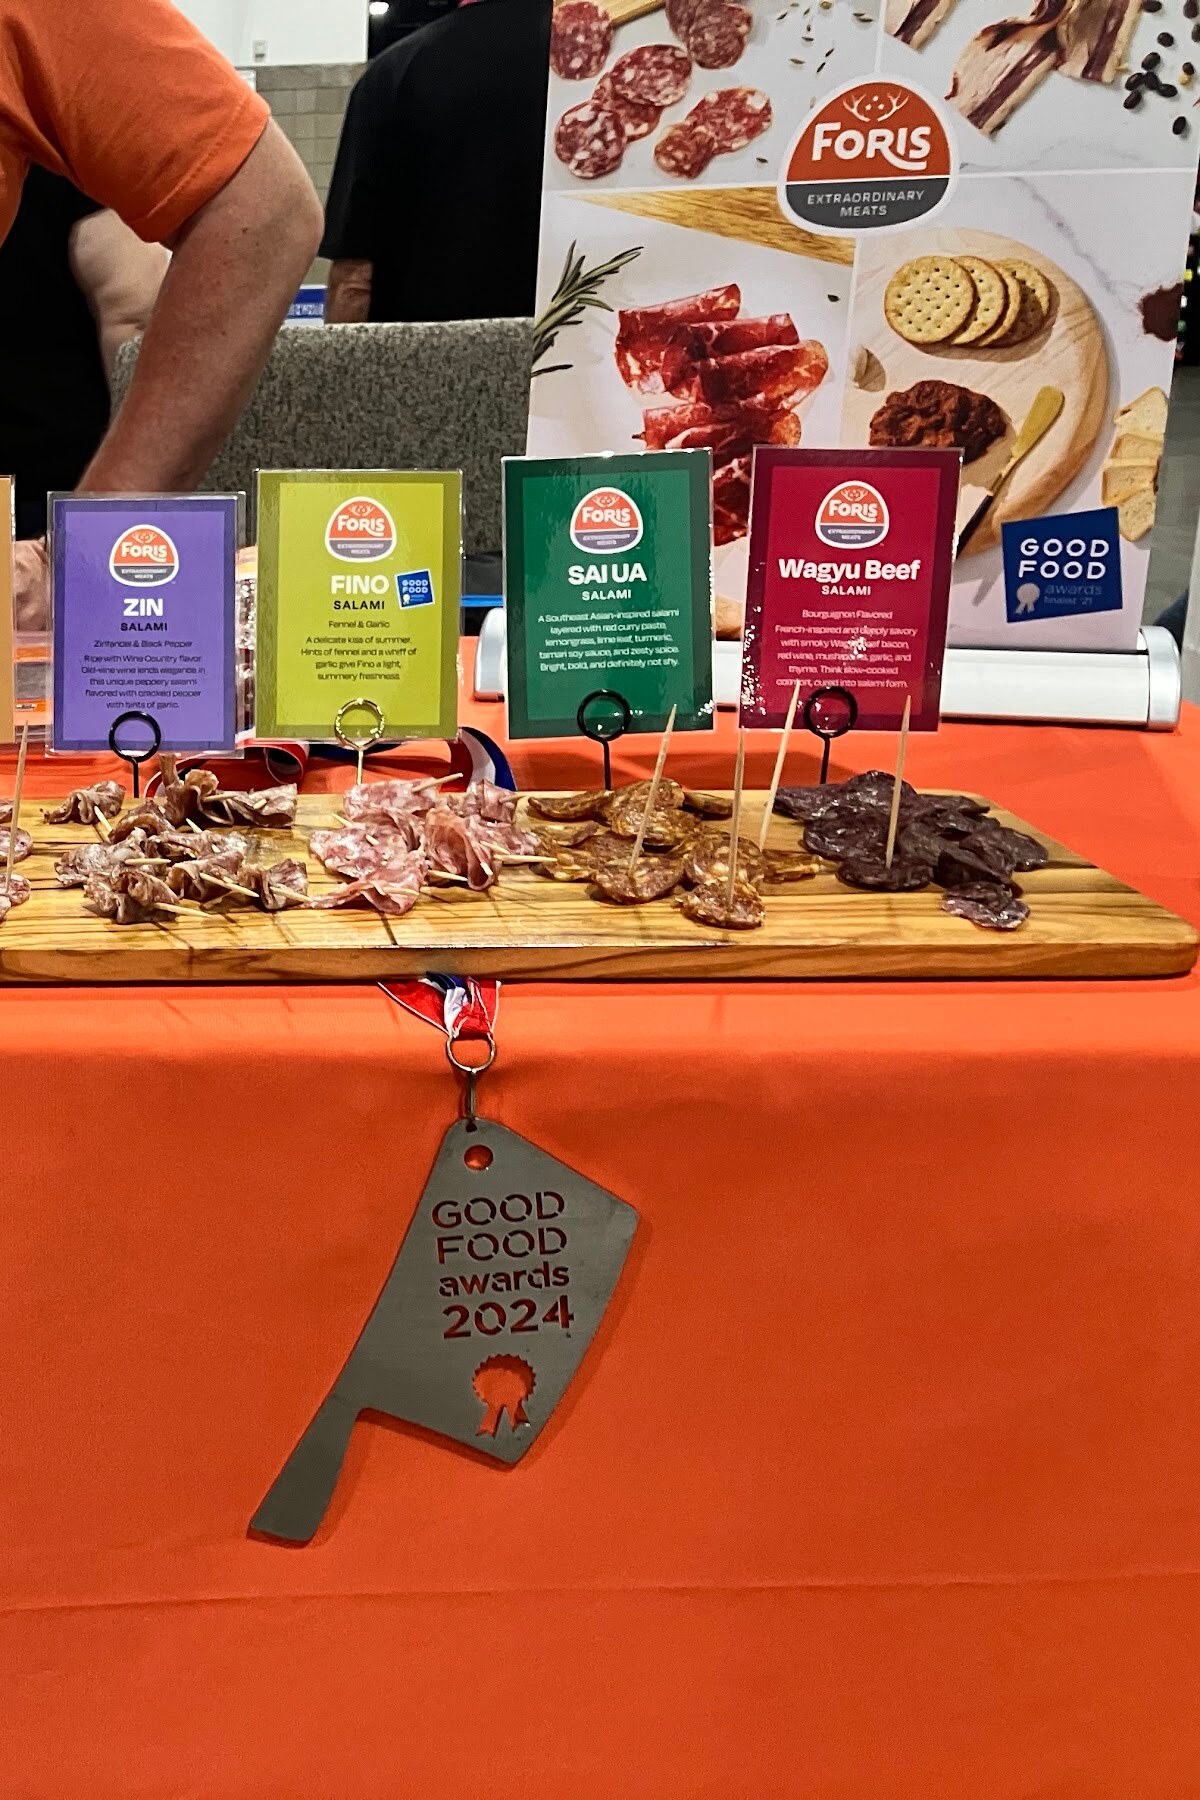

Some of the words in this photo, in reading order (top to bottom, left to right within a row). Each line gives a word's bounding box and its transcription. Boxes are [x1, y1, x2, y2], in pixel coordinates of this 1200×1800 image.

[812, 122, 931, 170] FORIS
[808, 190, 924, 204] EXTRAORDINARY
[840, 205, 887, 217] MEATS
[582, 507, 630, 527] FORIS
[829, 499, 878, 522] FORIS
[338, 515, 385, 537] FORIS
[121, 542, 167, 562] FORIS
[1021, 538, 1109, 557] GOOD
[568, 565, 607, 585] SAI
[612, 563, 648, 583] UA
[778, 558, 860, 583] Wagyu
[865, 560, 921, 580] Beef
[1019, 560, 1106, 579] FOOD
[331, 575, 389, 595] FINO
[403, 586, 428, 594] FOOD
[821, 585, 871, 595] SALAMI
[1045, 585, 1102, 595] awards
[582, 589, 631, 601] SALAMI
[123, 599, 163, 616] ZIN
[334, 600, 385, 610] SALAMI
[121, 623, 168, 631] SALAMI
[550, 626, 581, 635] layered
[618, 624, 640, 632] curry
[164, 640, 192, 648] Pepper
[432, 1191, 564, 1228] GOOD
[437, 1227, 567, 1264] FOOD
[439, 1261, 569, 1297] awards
[443, 1295, 574, 1339] 2024
